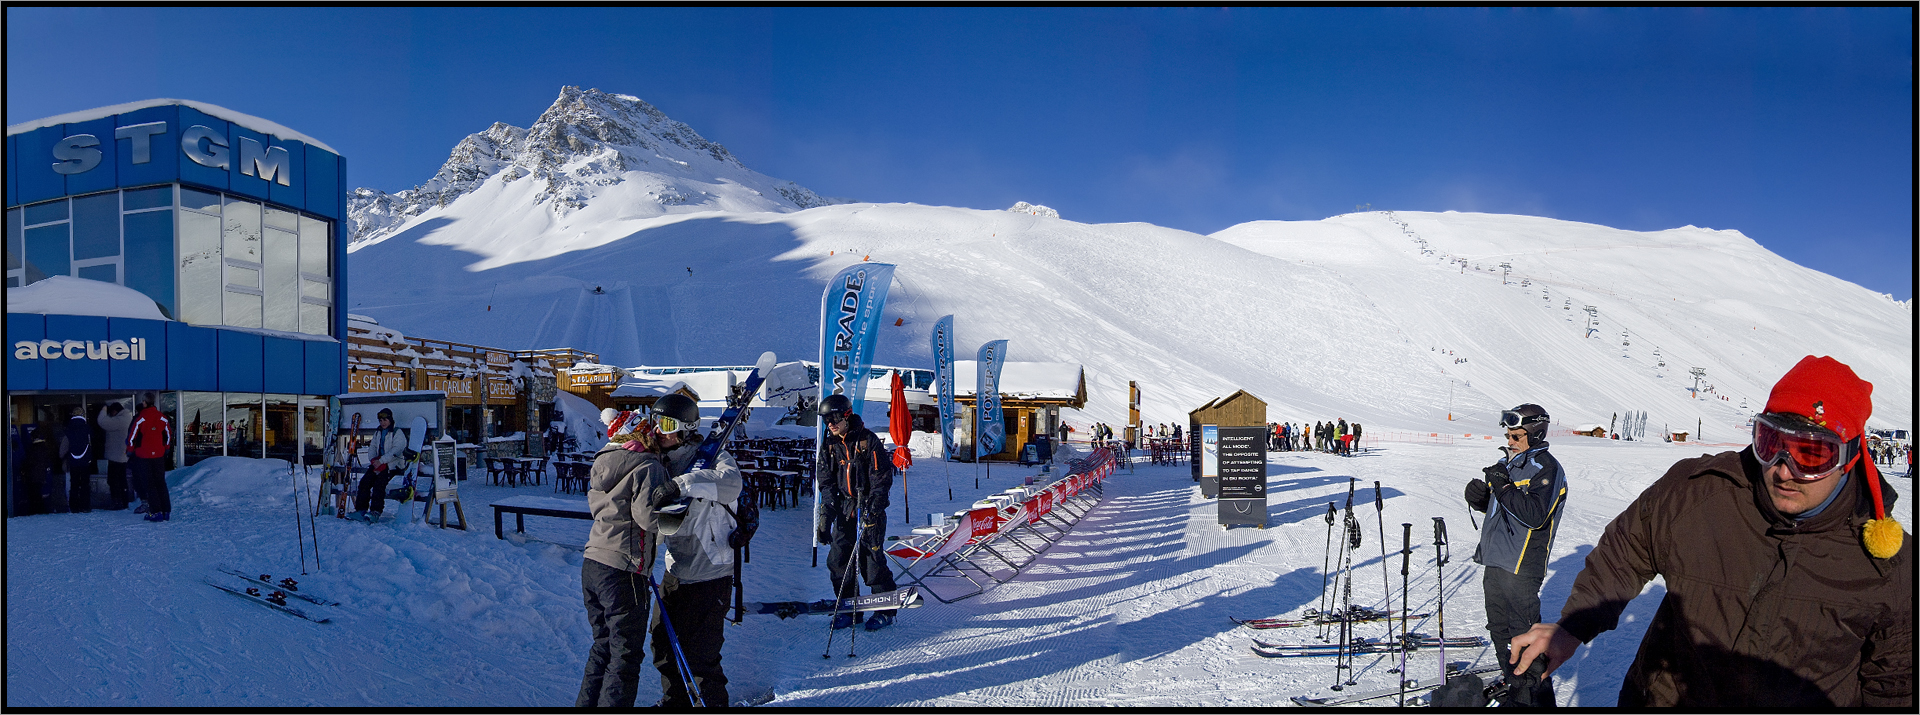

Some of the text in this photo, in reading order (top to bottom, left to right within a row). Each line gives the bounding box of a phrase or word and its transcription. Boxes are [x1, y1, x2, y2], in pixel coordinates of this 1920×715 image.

[52, 121, 290, 186] STGM
[832, 273, 865, 396] WERADE
[14, 337, 146, 361] accueil
[428, 380, 472, 395] LE CARLINE
[577, 375, 609, 383] SOLARIUM
[972, 515, 994, 532] Coca-Cola
[844, 595, 891, 607] SALOMON
